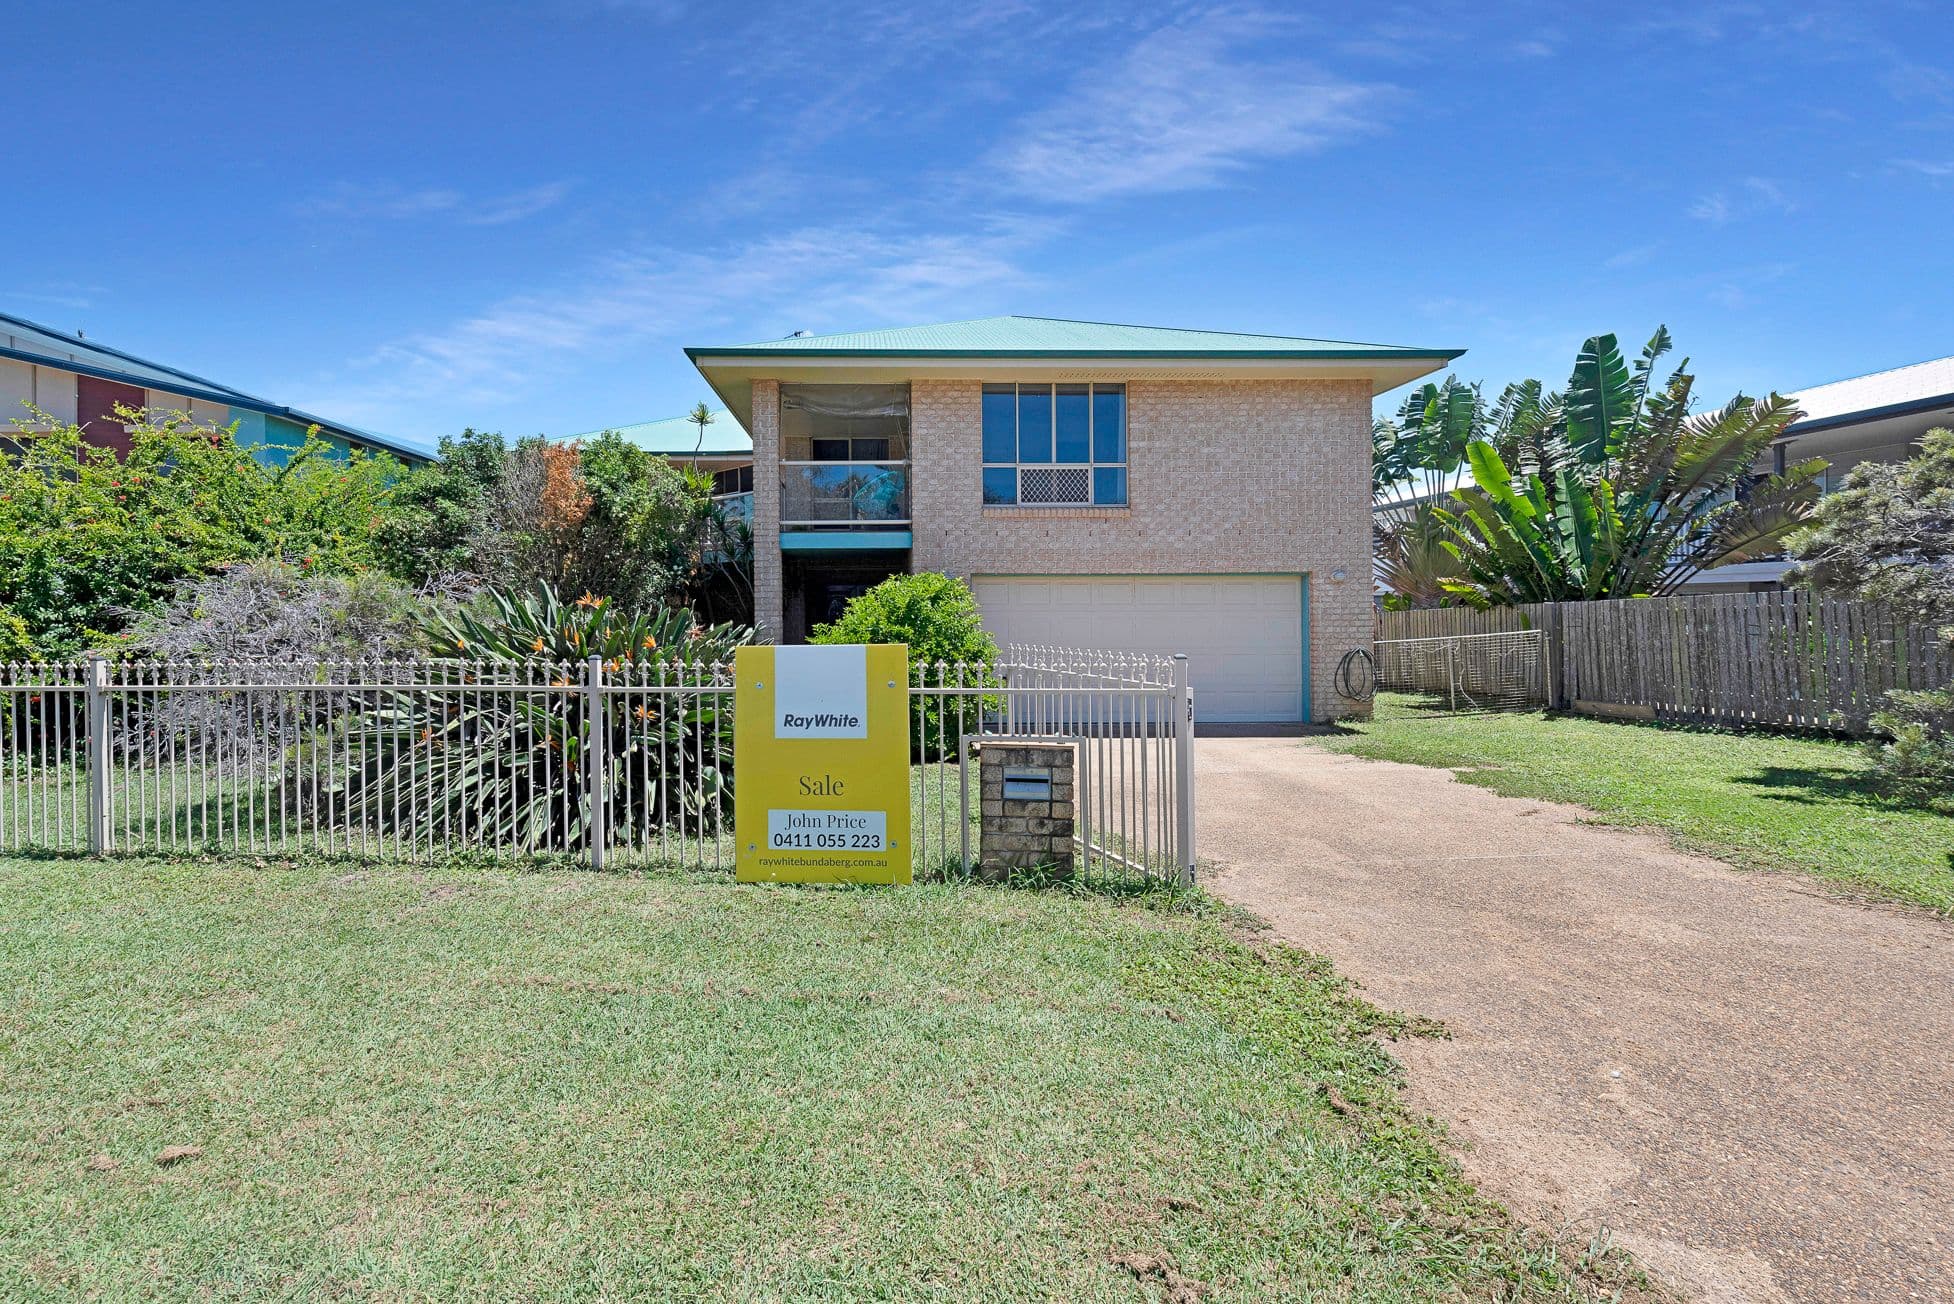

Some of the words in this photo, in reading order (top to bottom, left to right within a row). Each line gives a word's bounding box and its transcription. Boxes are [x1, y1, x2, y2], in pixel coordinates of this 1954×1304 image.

[799, 775, 844, 796] Sale
[784, 814, 822, 830] John
[827, 814, 866, 829] Price
[774, 833, 812, 847] 0411
[817, 834, 846, 848] 055
[851, 834, 880, 848] 223
[759, 857, 887, 869] raywhitebundaberg.com.au
